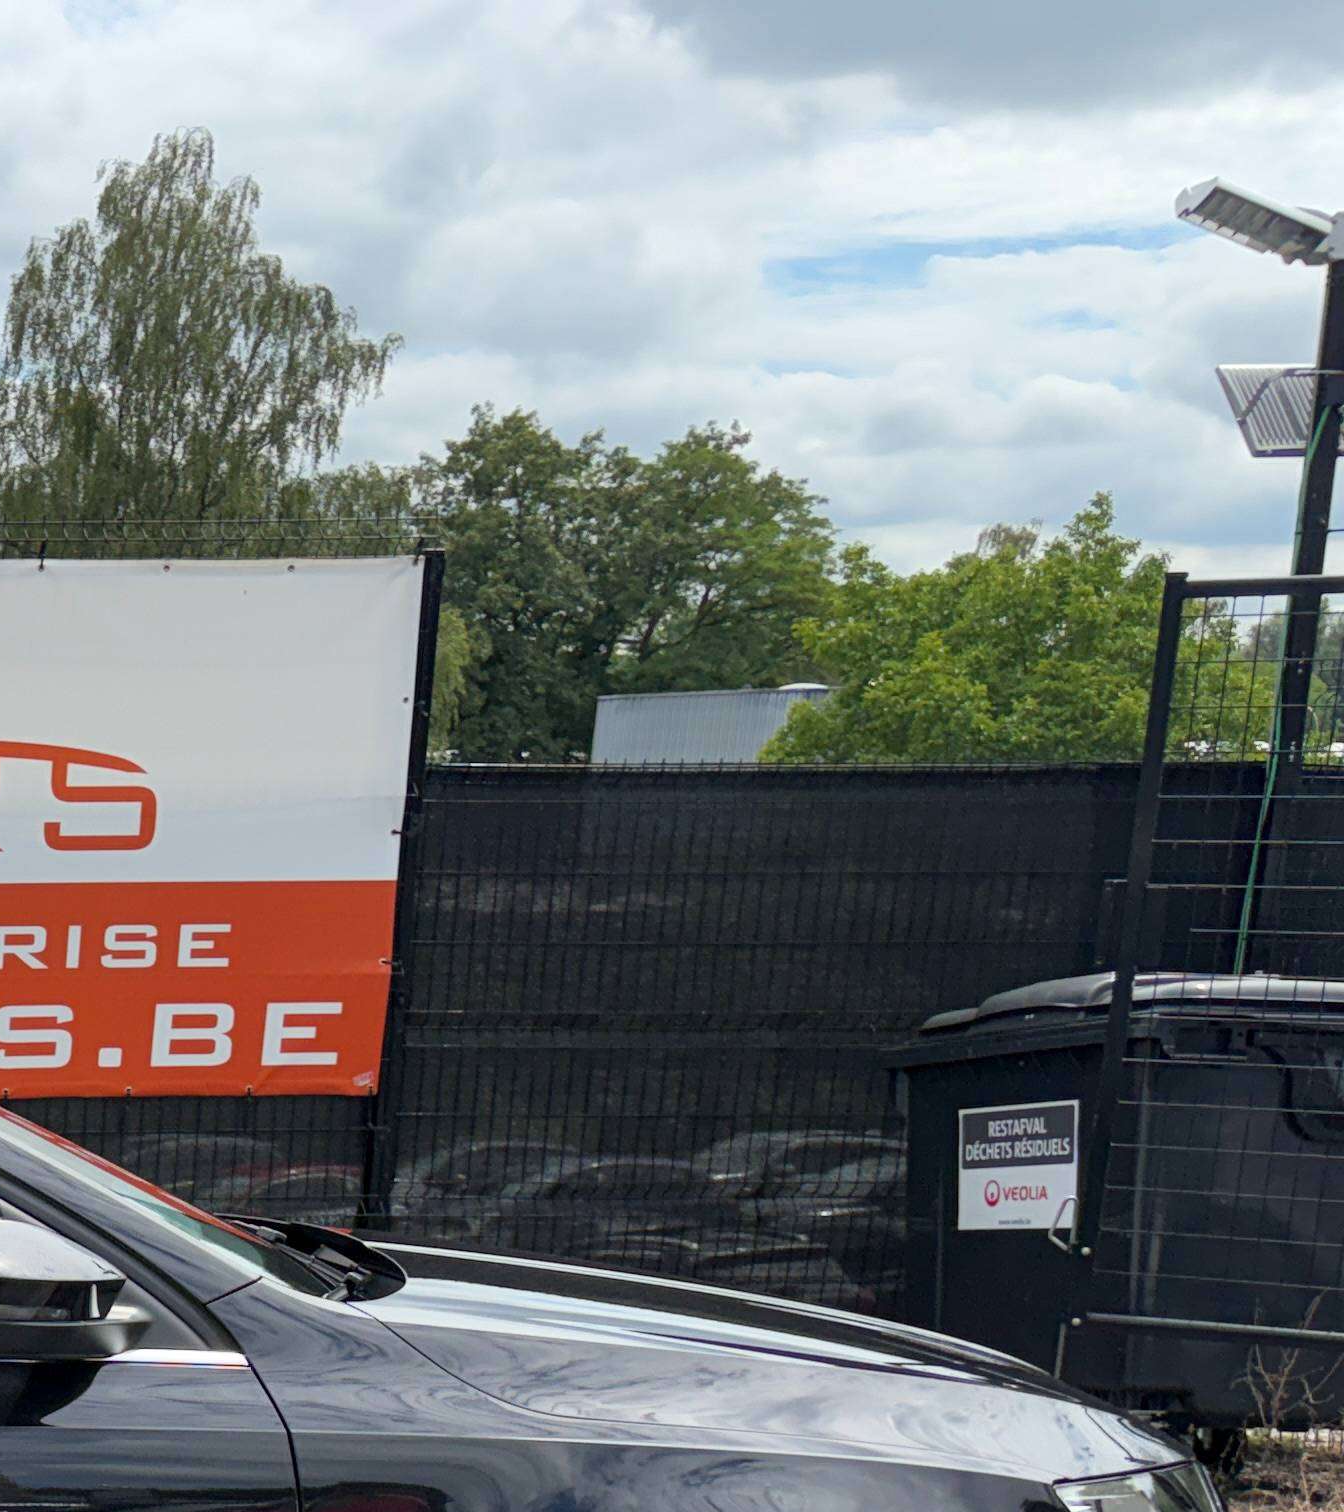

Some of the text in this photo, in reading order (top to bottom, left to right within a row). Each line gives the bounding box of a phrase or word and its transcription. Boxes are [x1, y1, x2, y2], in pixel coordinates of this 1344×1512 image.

[987, 1117, 1047, 1137] RESTAFVAL
[965, 1137, 1070, 1161] DÉCHETS RÉSIDUELS
[1003, 1185, 1048, 1200] VEOLIA
